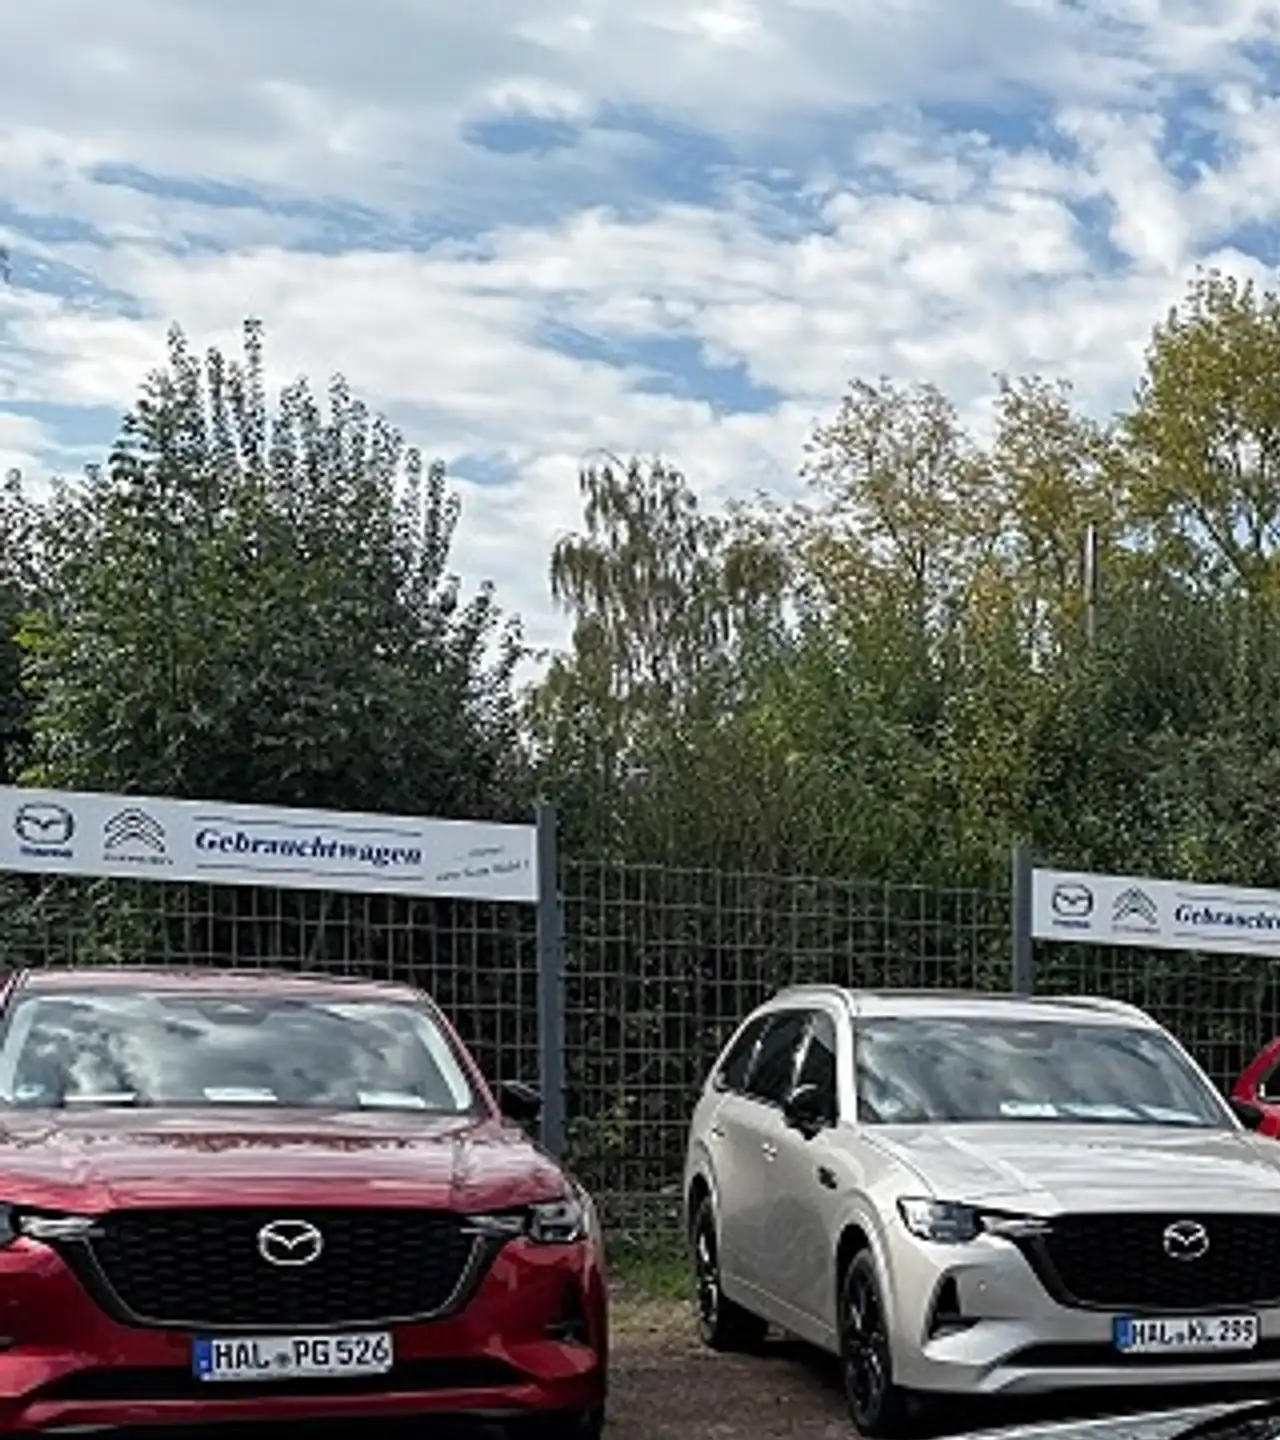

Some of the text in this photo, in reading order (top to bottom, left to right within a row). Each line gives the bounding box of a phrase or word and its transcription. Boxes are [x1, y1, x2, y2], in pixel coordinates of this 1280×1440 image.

[195, 828, 422, 866] Gebrauchtwagen
[1131, 1322, 1173, 1345] HAL
[215, 1336, 390, 1370] HAL PG 526
